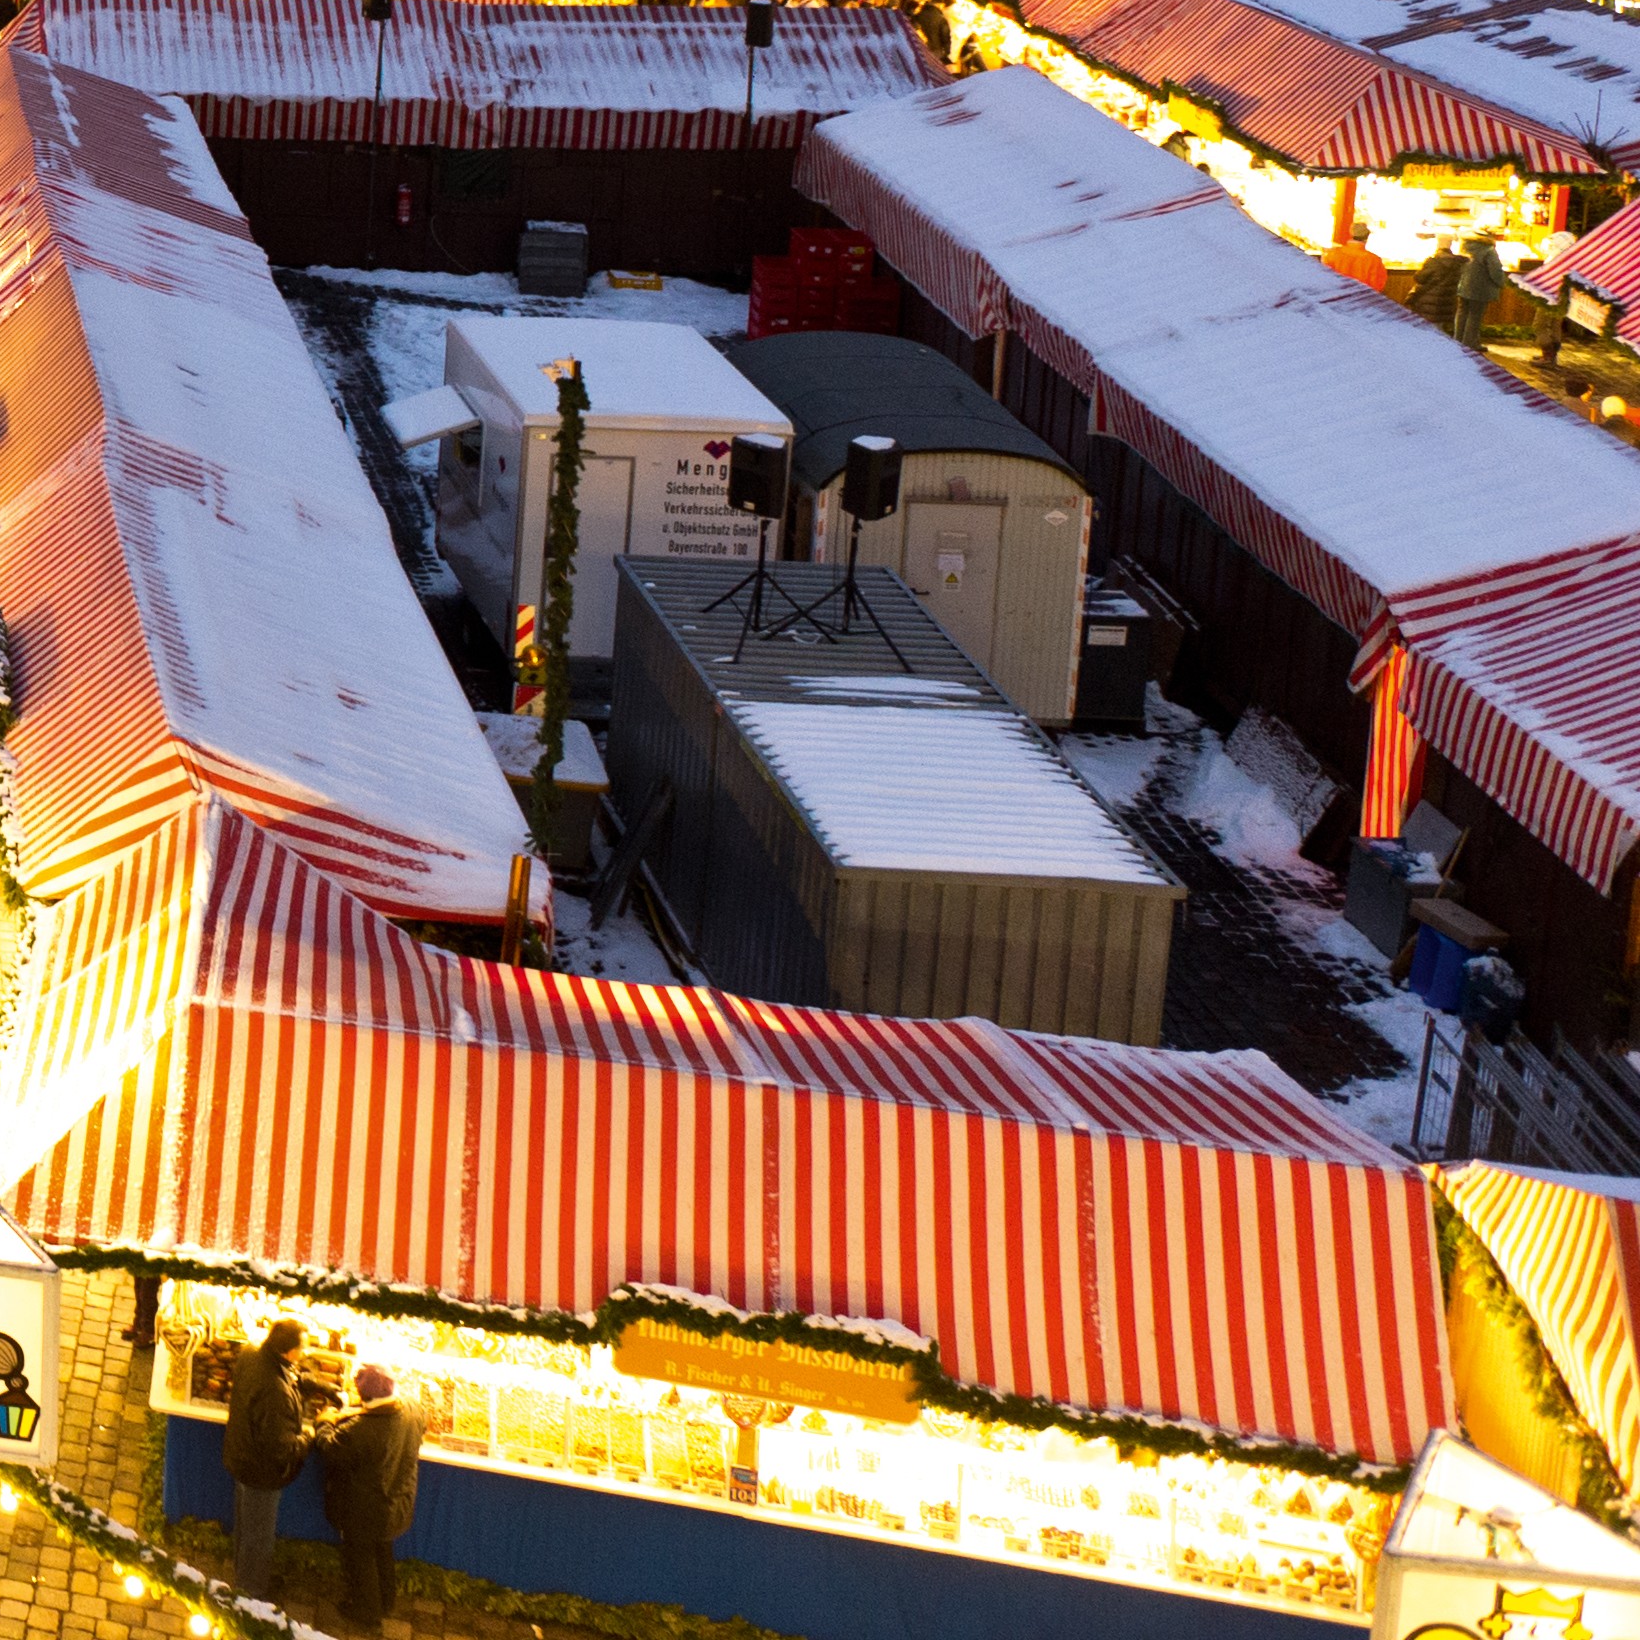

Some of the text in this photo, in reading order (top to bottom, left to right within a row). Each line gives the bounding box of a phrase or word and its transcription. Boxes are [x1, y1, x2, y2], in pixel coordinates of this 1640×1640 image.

[666, 481, 729, 497] Sicherheits
[673, 520, 730, 537] Objektschutz
[732, 524, 759, 537] GmbH
[668, 539, 727, 556] Bayernstraße
[686, 1362, 737, 1390] Fischer
[740, 1373, 752, 1389] &
[779, 1380, 827, 1403] Singer
